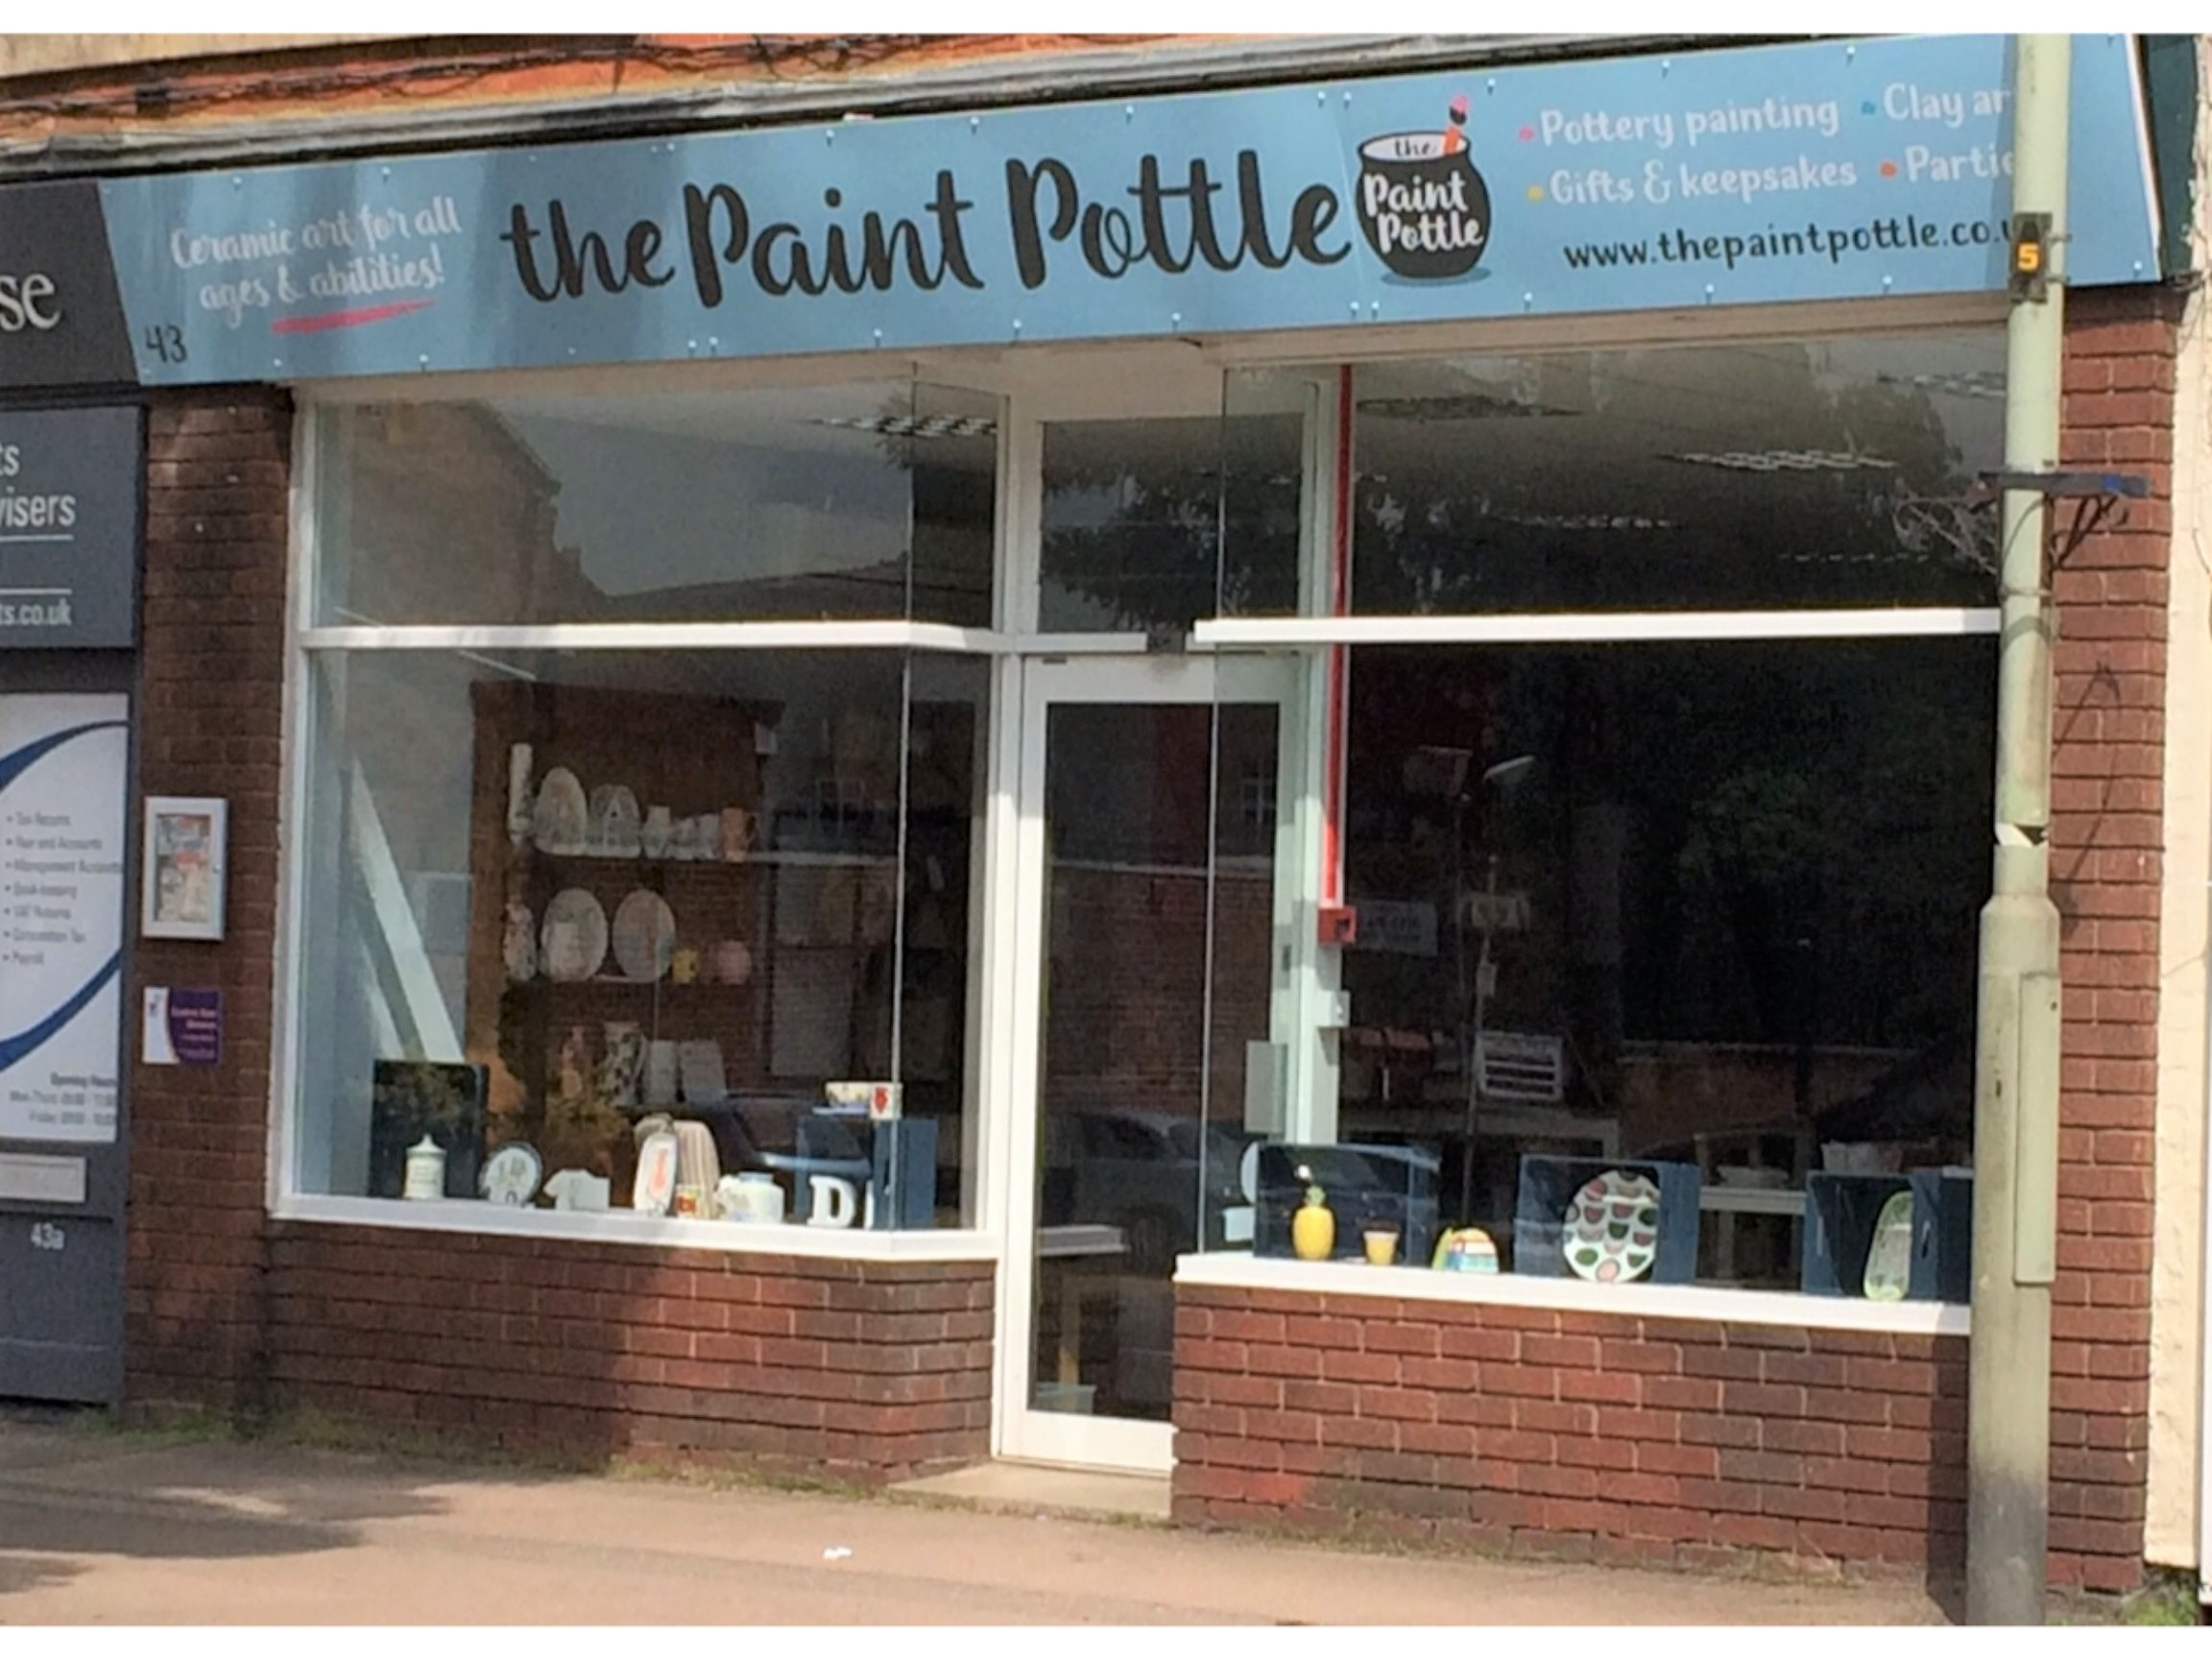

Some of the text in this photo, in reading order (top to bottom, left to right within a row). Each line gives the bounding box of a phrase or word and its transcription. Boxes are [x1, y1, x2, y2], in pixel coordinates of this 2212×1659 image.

[1539, 97, 1839, 149] Pottery painting
[1883, 83, 2012, 129] Clay ar
[1394, 139, 1436, 156] the
[1363, 170, 1469, 218] Paint
[1550, 154, 1857, 205] Gifts & keepsakes
[170, 196, 462, 270] Ceramic art for all
[499, 149, 1353, 308] the Paint Pottle
[1377, 209, 1485, 254] Pottle
[2017, 241, 2039, 274] 5
[0, 273, 62, 332] se
[199, 243, 445, 330] ages & abilities!
[144, 324, 188, 365] 43
[30, 1221, 66, 1250] 43a
